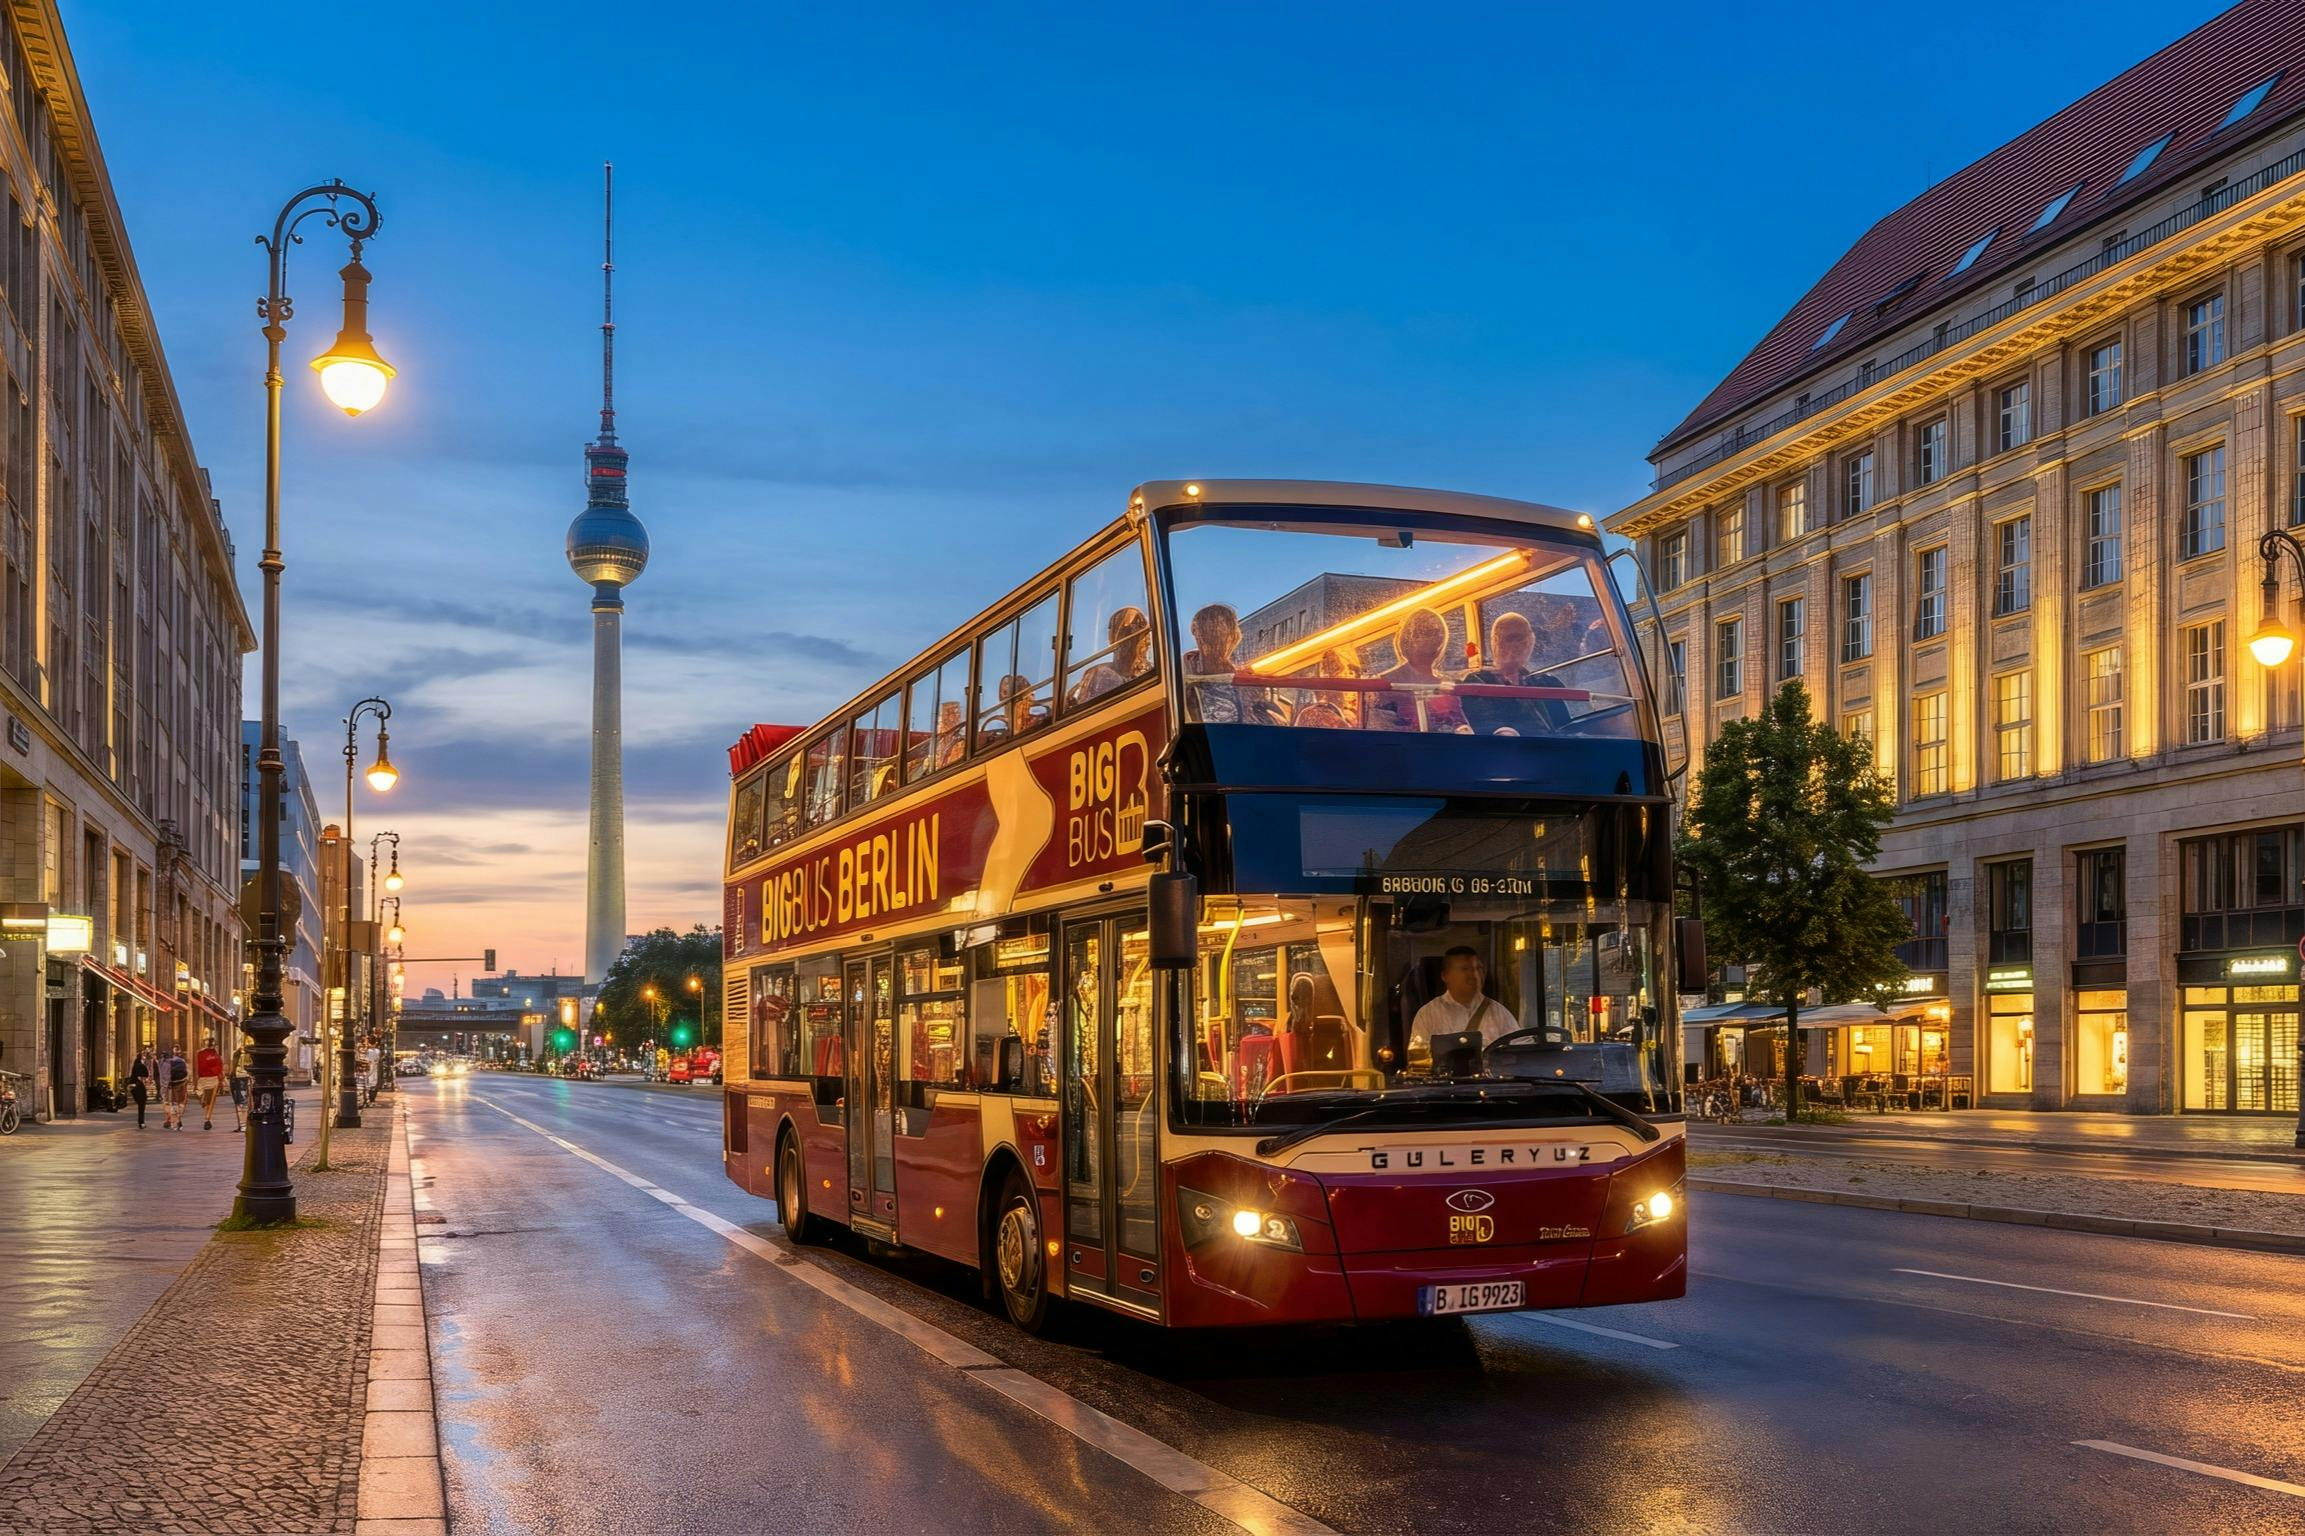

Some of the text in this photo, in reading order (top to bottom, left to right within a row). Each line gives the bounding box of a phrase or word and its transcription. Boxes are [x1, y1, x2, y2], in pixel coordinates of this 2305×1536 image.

[1070, 741, 1114, 811] BIG
[838, 812, 940, 924] BERLIN
[1069, 807, 1113, 868] BUS
